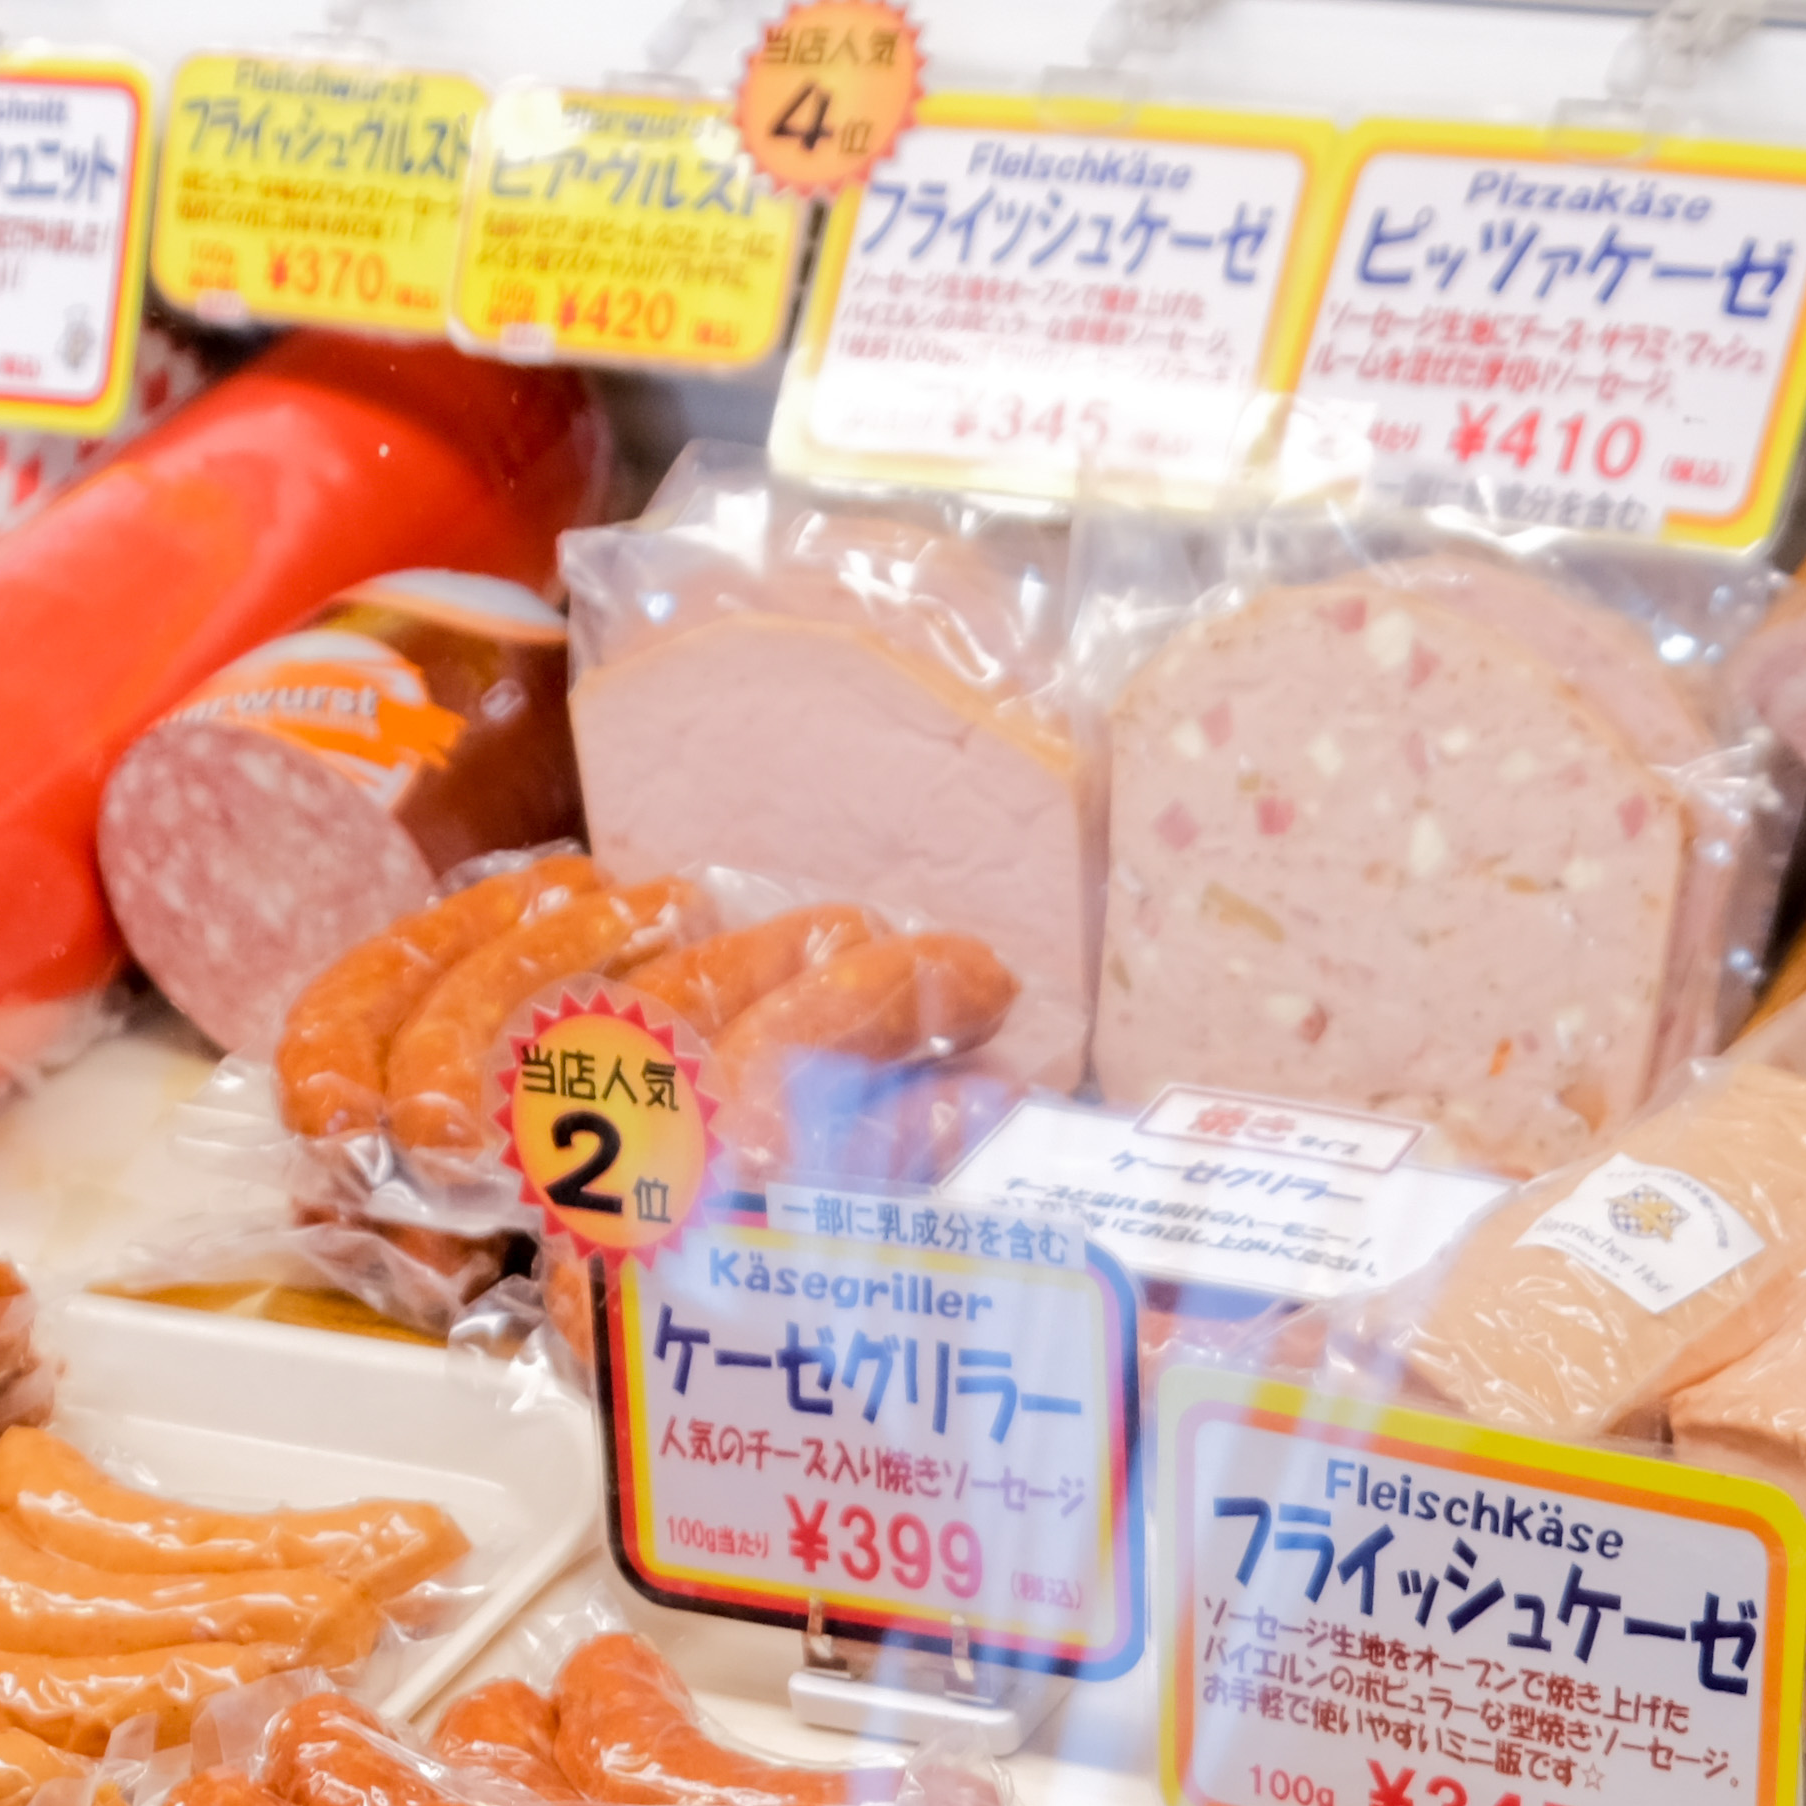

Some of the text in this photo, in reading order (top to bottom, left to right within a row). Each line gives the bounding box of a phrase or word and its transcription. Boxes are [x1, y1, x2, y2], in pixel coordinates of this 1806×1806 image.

[765, 27, 901, 68] 当店人気
[268, 241, 386, 302] ¥370
[557, 282, 677, 341] ¥420
[1449, 402, 1645, 480] ¥410
[520, 1044, 680, 1112] 当店人気
[781, 1193, 1070, 1265] 一部に乳成分を含む
[708, 1247, 994, 1322] Käsegriller
[653, 1303, 1083, 1445] ケーゼグリラー
[659, 1417, 1086, 1516] 人気のチーズ入り焼きソーセージ
[1324, 1457, 1624, 1560] Fleischkäse
[666, 1515, 770, 1560] 100g当たり
[783, 1494, 984, 1600] ¥399
[1212, 1494, 1758, 1697] フライッシュケーゼ
